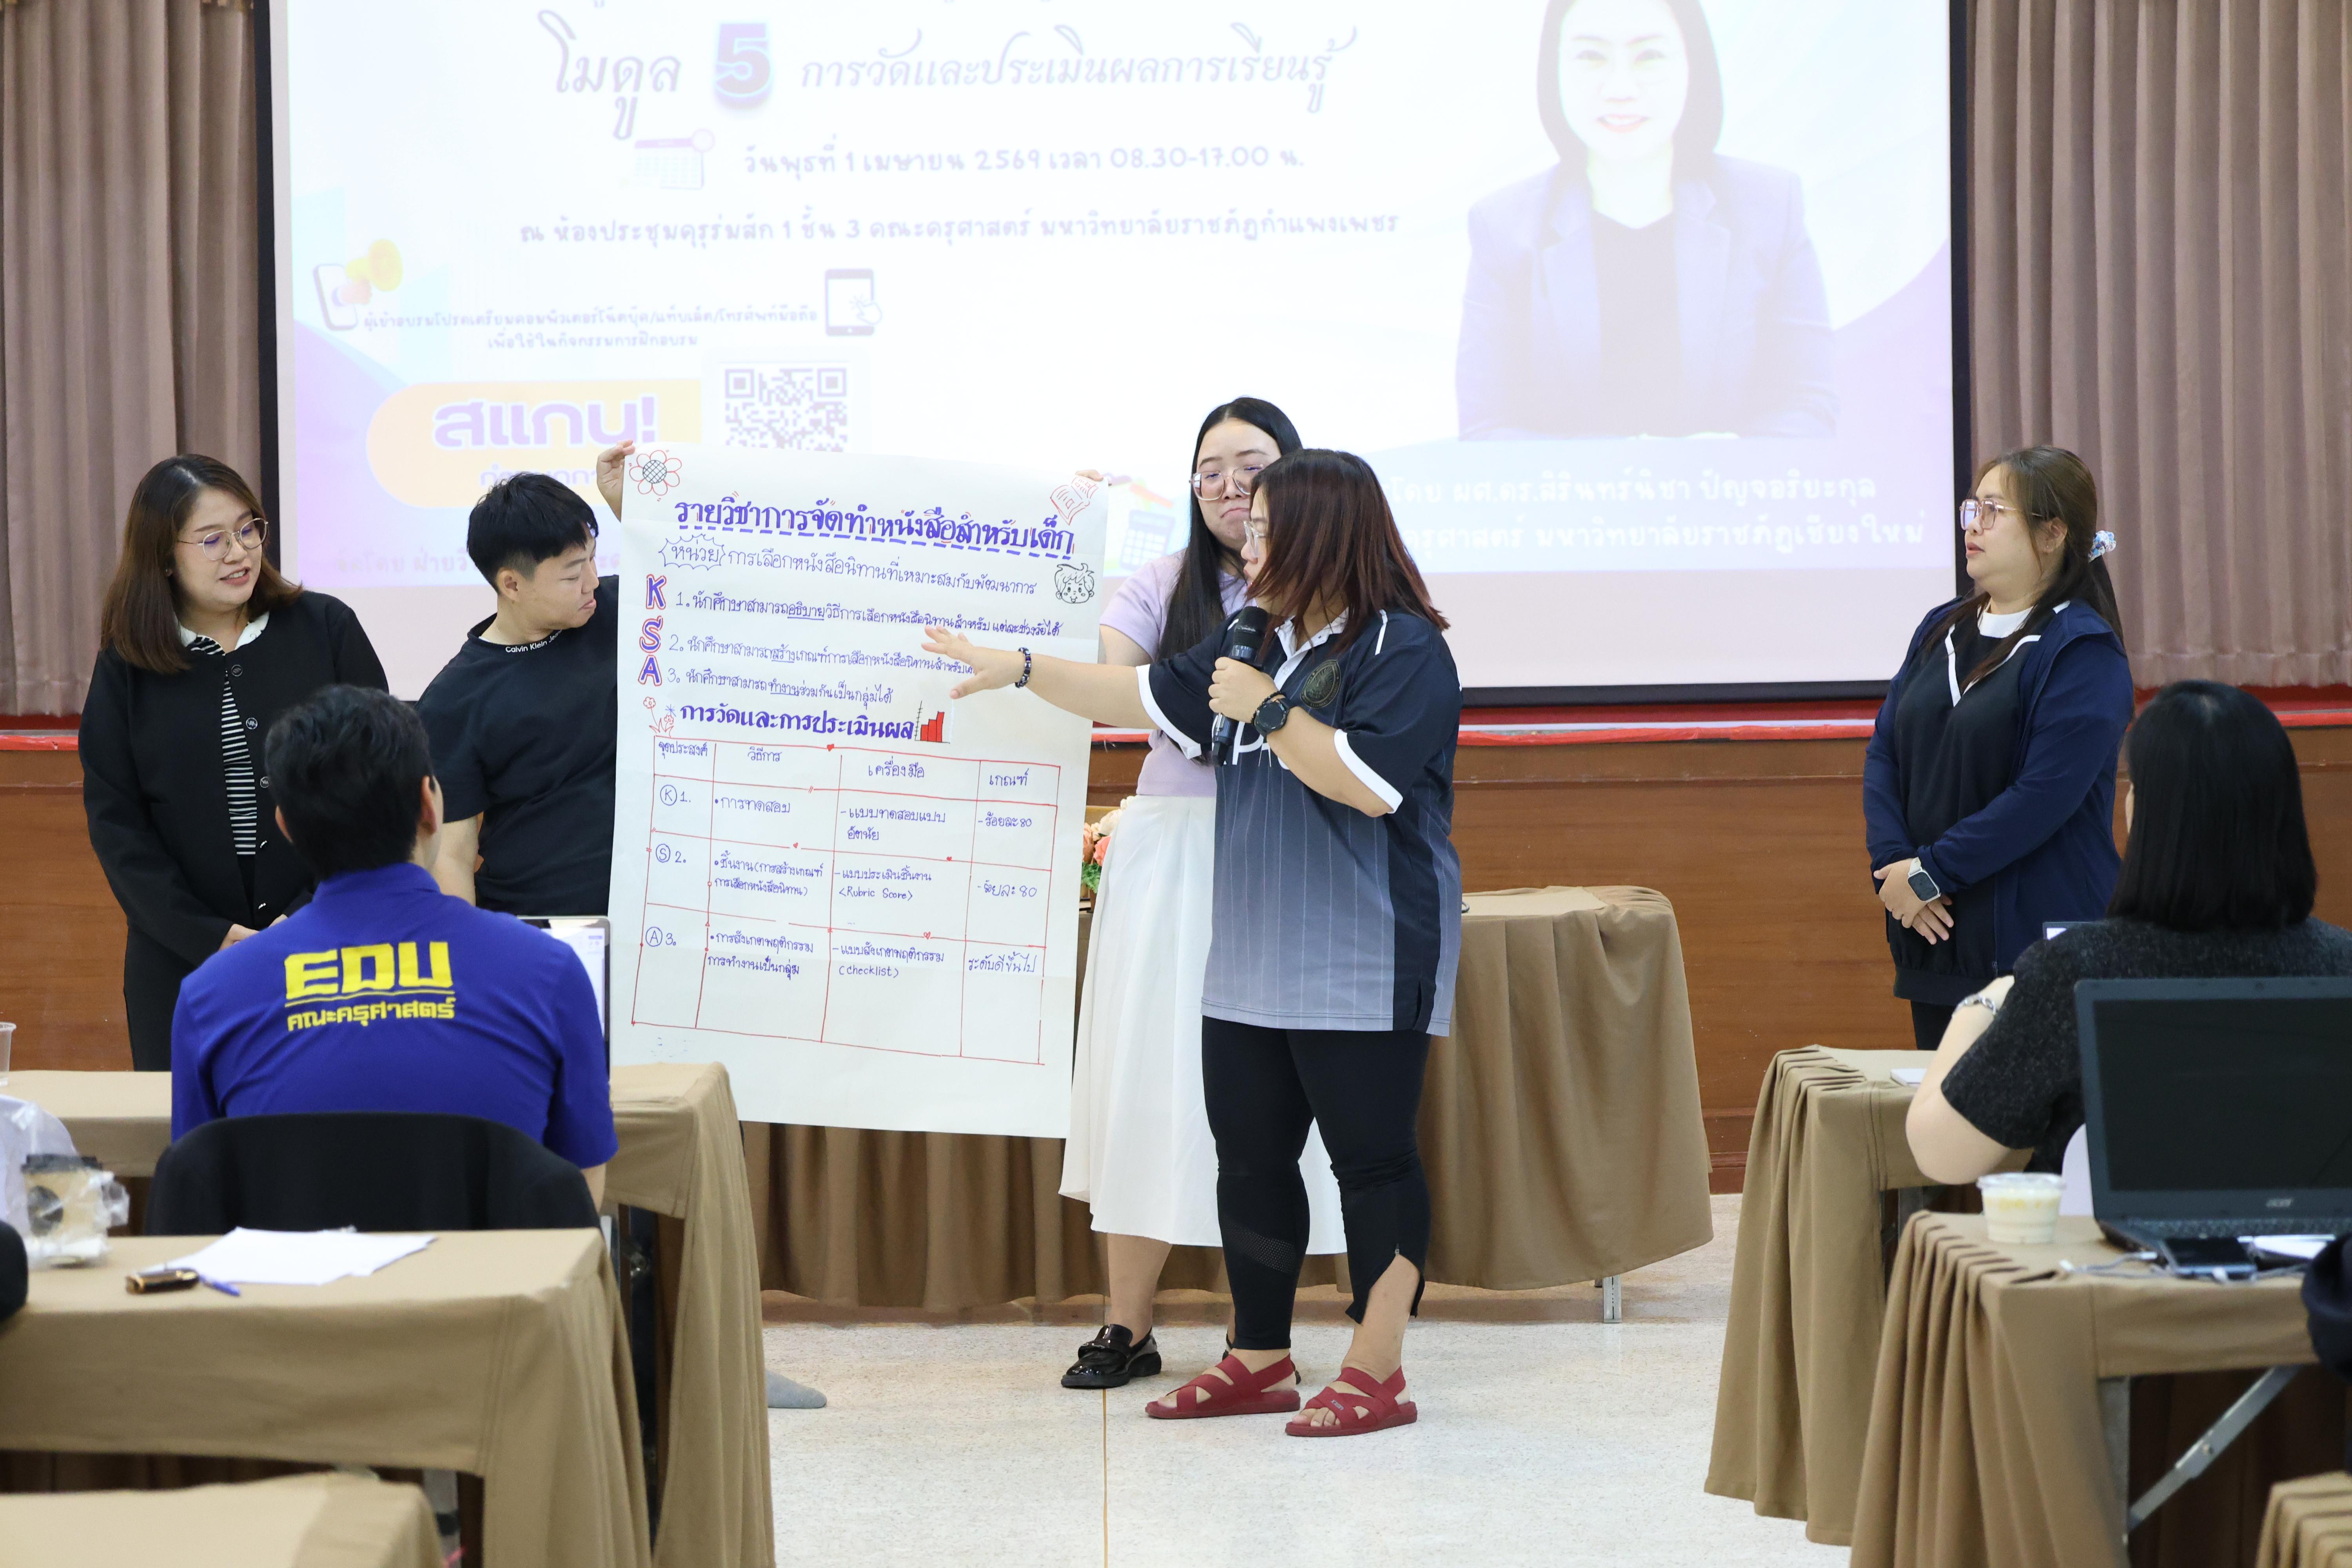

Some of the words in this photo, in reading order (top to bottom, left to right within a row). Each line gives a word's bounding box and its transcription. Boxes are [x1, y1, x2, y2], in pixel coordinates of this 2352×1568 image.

[537, 9, 682, 140] โมดูล
[715, 22, 773, 108] 5
[802, 22, 1357, 114] การวัดและประเมินผลการเรียนรู้
[745, 134, 836, 181] วันพุธที่
[845, 152, 855, 172] 1
[863, 151, 964, 172] เมษายน
[975, 150, 1040, 171] 2569
[1049, 151, 1101, 169] เวลา
[1110, 145, 1269, 169] 08.30-17.00
[1279, 149, 1305, 167] น.
[521, 224, 545, 242] ณ
[783, 220, 792, 239] 1
[802, 204, 835, 240] ชั้น
[846, 218, 860, 238] 3
[869, 208, 1034, 246] คณะครุศาสตร์
[1041, 208, 1399, 241] มหาวิทยาลัยราชภัฏกำแพงเพชร
[434, 396, 655, 448] สแกน!
[675, 497, 1074, 555] รายวิชาการจัดทำหนังสือสำหรับเด็ก
[1402, 513, 1526, 560] ครุศาสตร์
[1535, 509, 1925, 554] มหาวิทยาลัยราชภัฏเชียงใหม่
[412, 545, 467, 573] ฝ่ายวิ
[671, 539, 720, 563] หน่วย
[646, 575, 666, 609] K
[676, 592, 690, 608] 1.
[530, 641, 548, 651] Klein
[640, 616, 662, 652] S
[669, 634, 684, 652] 2.
[638, 655, 662, 686] A
[668, 668, 680, 683] 3.
[680, 704, 914, 739] การวัดและการประเมินผล
[659, 741, 708, 759] จุดประสงค์
[748, 747, 782, 762] วิธีการ
[868, 756, 925, 778] เครื่องมือ
[989, 768, 1029, 786] เกณฑ์
[847, 827, 879, 841] อัตนัย
[284, 941, 454, 1000] EDU
[287, 997, 456, 1032] คณะครุศาสตร์
